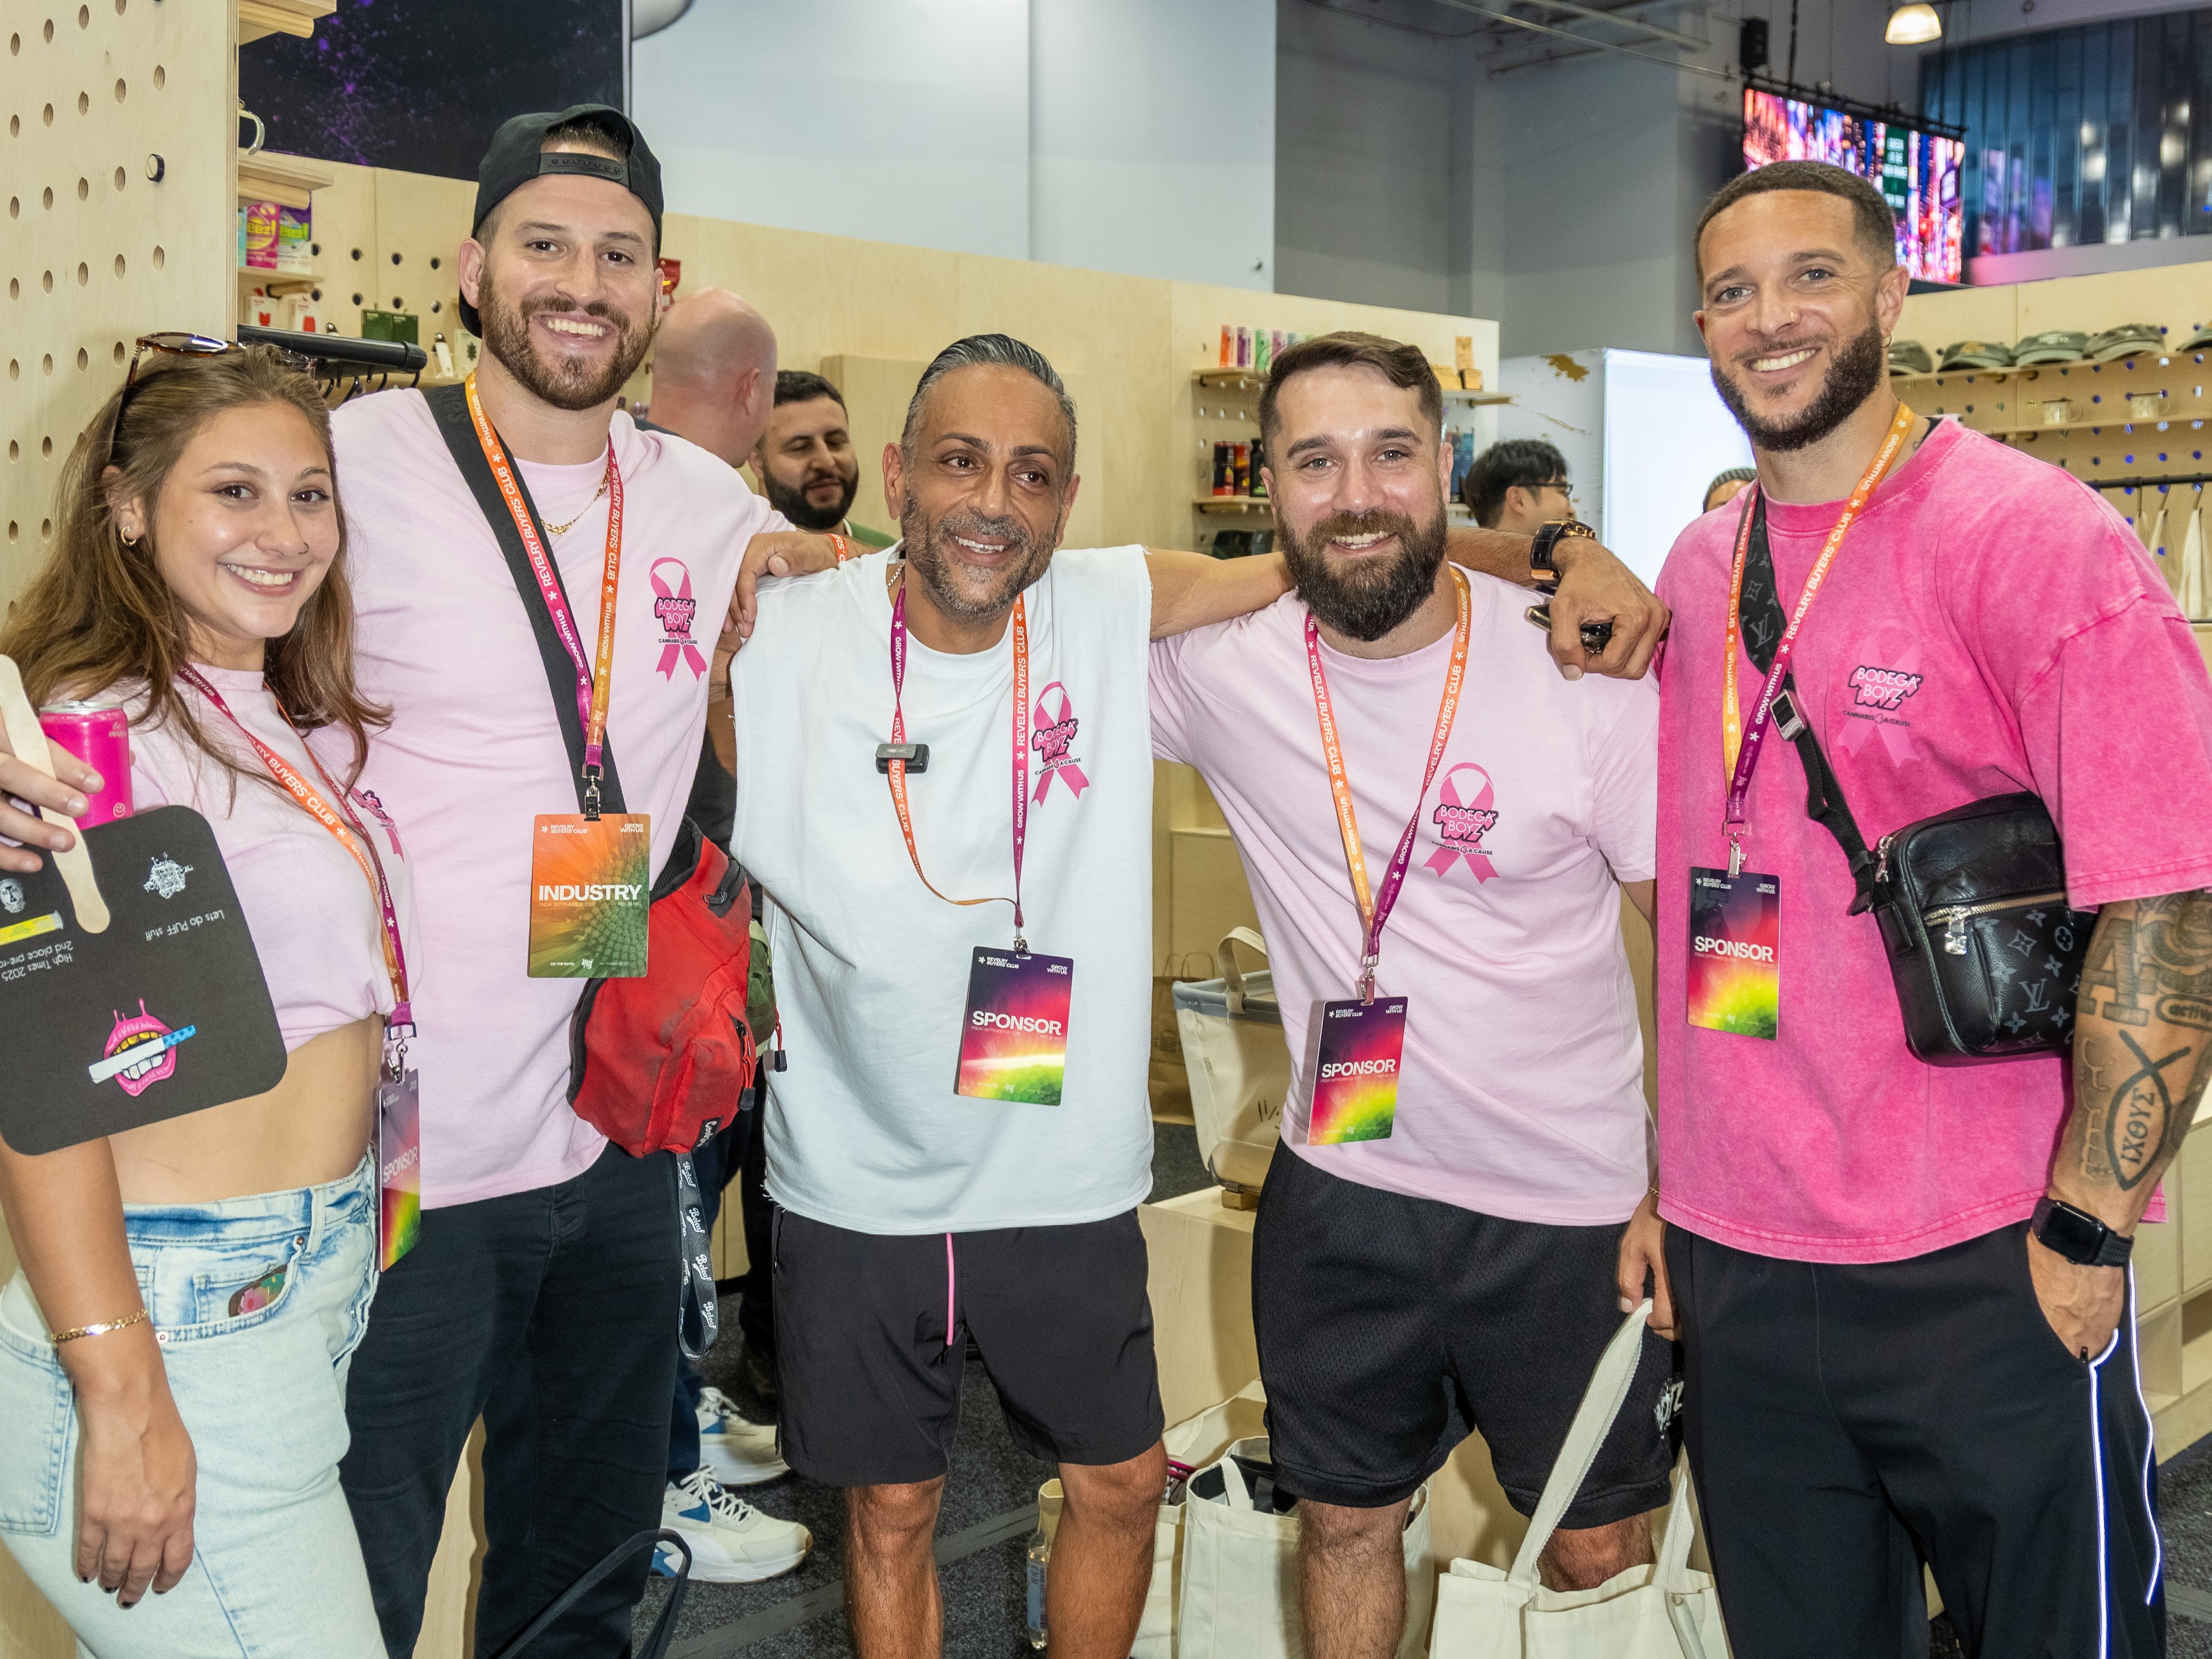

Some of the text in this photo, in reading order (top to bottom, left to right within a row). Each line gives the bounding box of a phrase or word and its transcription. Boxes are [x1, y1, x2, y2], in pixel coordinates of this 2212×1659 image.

[497, 466, 554, 587] REVELRY BUYERS' CLUB
[607, 467, 621, 581] REVELRY BUYERS' CLUB
[1730, 552, 1743, 598] BUYERS'
[1786, 512, 1853, 640] REVELRY BUYERS' CLUB
[658, 598, 695, 612] BODEGA
[666, 612, 690, 625] BOYZ
[1017, 626, 1026, 747] REVELRY BUYERS' CLUB
[1857, 667, 1918, 689] BODEGA
[1755, 663, 1783, 725] GROW WITH US
[1864, 684, 1904, 702] BOYZ
[1310, 655, 1342, 775] REVELRY BUYERS' CLUB
[1426, 665, 1462, 787] REVELRY BUYERS' CLUB
[1843, 710, 1875, 721] CANNABIS
[894, 717, 902, 744] REVE
[1036, 721, 1076, 743] BODEGA
[1046, 734, 1068, 753] BOYZ
[891, 759, 905, 803] BUYERS'
[1018, 769, 1024, 779] US
[1035, 764, 1054, 775] CANNABIS
[268, 758, 336, 826] BUYERS' CLUB
[898, 804, 910, 832] CLUB
[1441, 805, 1494, 823] BODEGA
[1448, 820, 1483, 835] BOYZ
[539, 884, 643, 901] INDUSTRY
[145, 909, 225, 942] Lets do PUFF stuff
[27, 940, 74, 958] 2nd place
[1694, 936, 1774, 962] SPONSOR
[1, 953, 73, 982] High Times 2025
[972, 1010, 1062, 1036] SPONSOR
[1321, 1058, 1396, 1078] SPONSOR
[383, 1146, 419, 1183] SPONSOR
[681, 1161, 696, 1188] Beleaf
[686, 1207, 705, 1234] Beleaf
[692, 1254, 712, 1281] Beleaf
[701, 1301, 717, 1329] Beleaf
